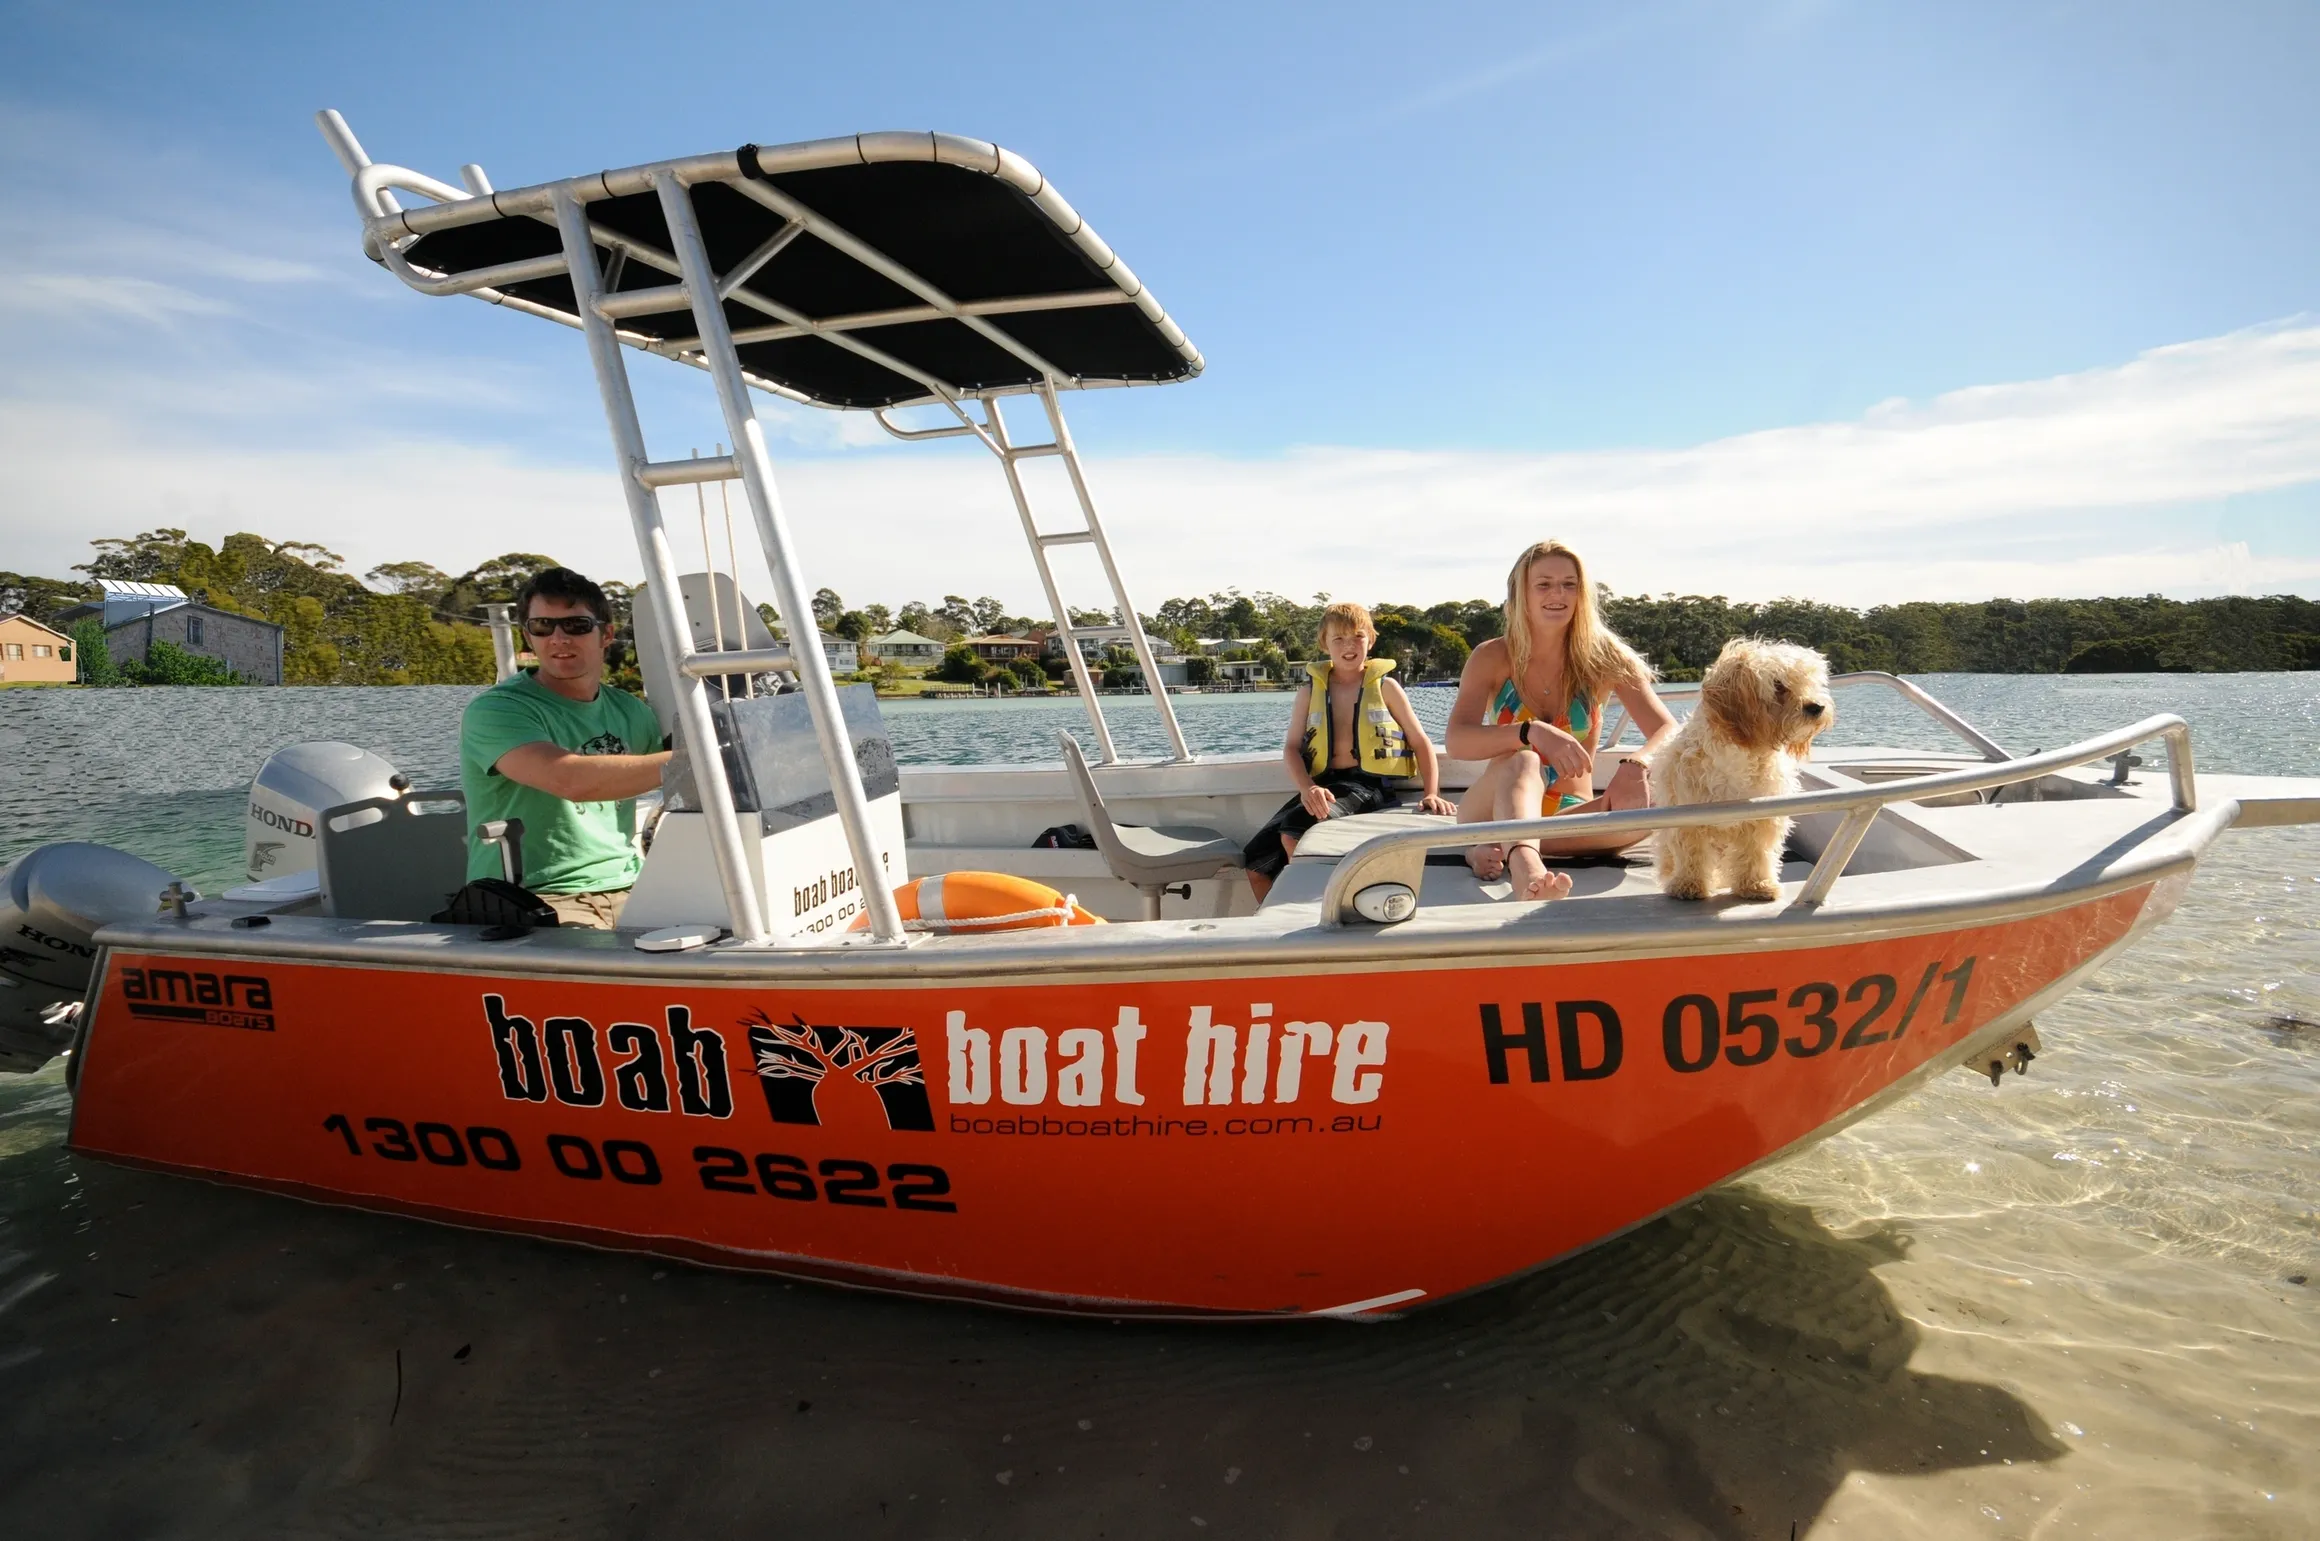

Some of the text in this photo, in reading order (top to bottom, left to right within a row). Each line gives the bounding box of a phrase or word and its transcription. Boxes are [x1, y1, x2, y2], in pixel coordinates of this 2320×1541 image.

[250, 802, 316, 839] HOND
[794, 875, 827, 917] boab
[798, 914, 833, 934] 300
[838, 902, 855, 920] 00
[121, 967, 273, 1011] amara
[1479, 956, 1977, 1085] HD 0532/1
[482, 993, 1390, 1119] boab boat hire
[949, 1113, 1383, 1137] boabboathire.com.au
[323, 1113, 958, 1213] 1300 00 2622
